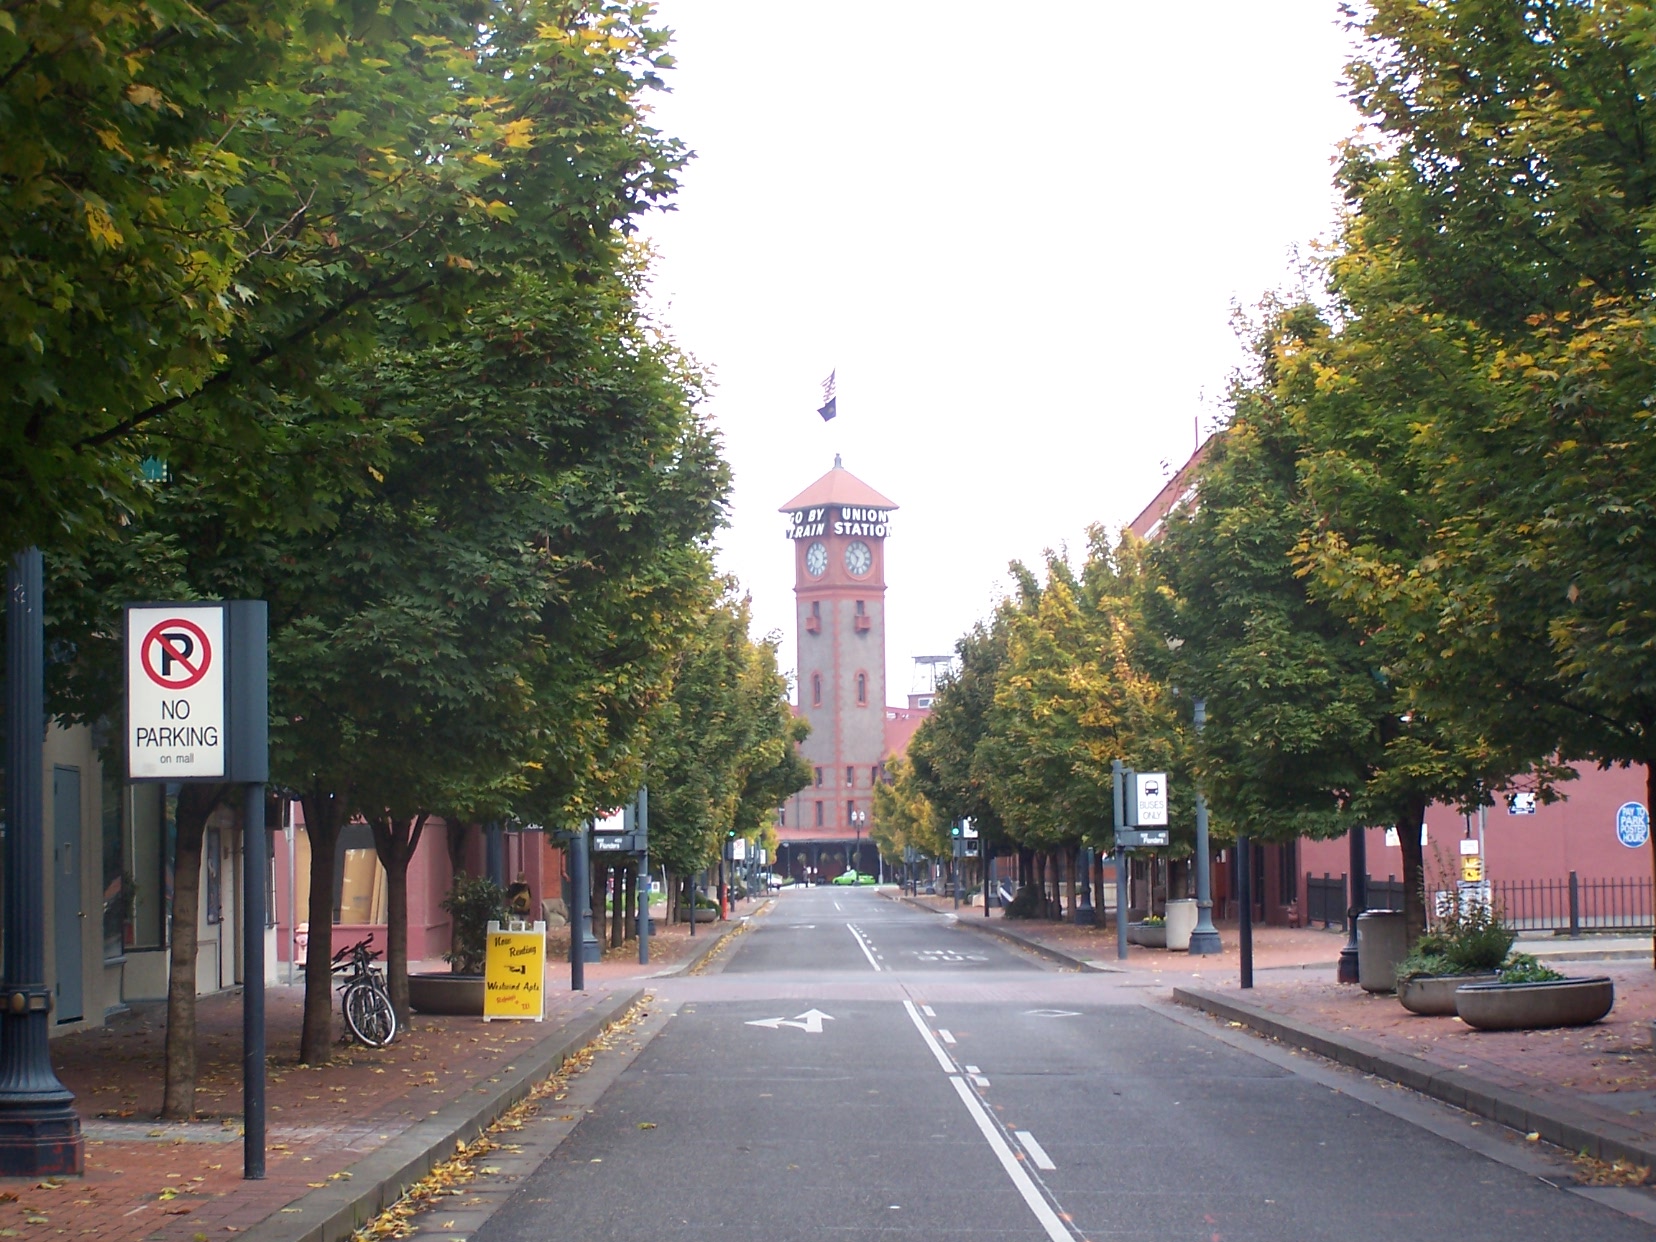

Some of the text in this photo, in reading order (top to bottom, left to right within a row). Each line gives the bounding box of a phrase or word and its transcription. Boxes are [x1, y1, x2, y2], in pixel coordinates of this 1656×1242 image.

[808, 508, 824, 522] BY
[842, 507, 888, 523] UNION
[787, 523, 825, 539] TRAIN
[161, 699, 191, 720] NO
[136, 726, 218, 747] PARKING
[160, 753, 195, 764] on mall
[1139, 800, 1165, 810] BUSES
[1142, 811, 1162, 820] ONLY
[1622, 807, 1646, 816] PAY TO
[1620, 816, 1645, 825] PARK
[1620, 824, 1647, 833] POSTED
[1622, 832, 1646, 843] HOURS
[508, 946, 537, 958] Renting
[487, 981, 540, 993] Westwind Apts
